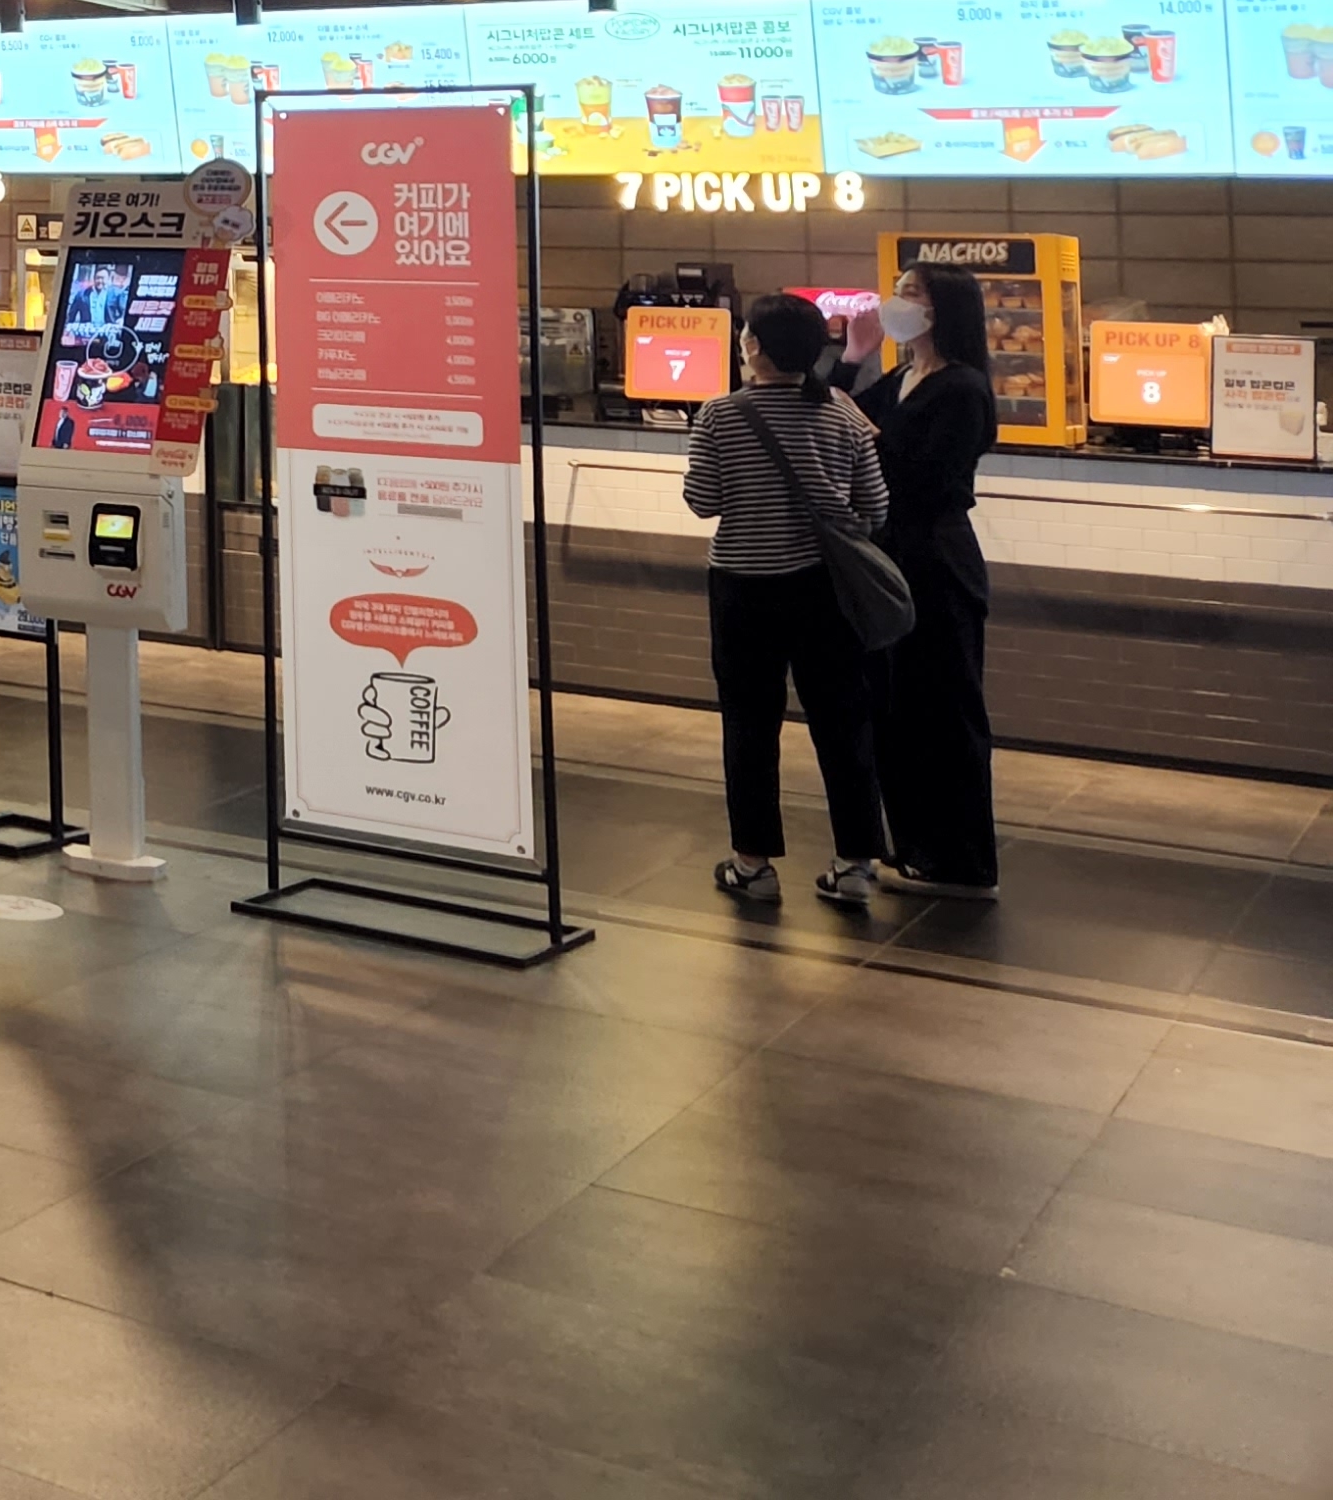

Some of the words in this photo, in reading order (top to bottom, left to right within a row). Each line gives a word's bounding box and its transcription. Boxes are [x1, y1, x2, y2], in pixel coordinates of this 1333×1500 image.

[361, 142, 415, 165] CGV
[76, 192, 120, 207] 주문은
[125, 192, 160, 207] 여기!
[393, 183, 471, 211] 커피가
[615, 173, 643, 210] 7
[654, 172, 755, 212] PICK
[761, 174, 822, 212] UP
[833, 171, 865, 212] 8
[72, 211, 185, 239] 키오스크
[394, 211, 471, 239] 여기에
[395, 240, 472, 267] 있어요
[918, 241, 1009, 264] NACHOS
[192, 273, 219, 286] TIP!
[638, 313, 678, 330] PICK
[680, 315, 702, 330] UP
[708, 317, 719, 331] 7
[1104, 330, 1151, 347] PICK
[1155, 333, 1181, 348] UP
[1188, 334, 1201, 348] 8
[668, 360, 687, 381] 7
[1142, 381, 1162, 404] 8
[107, 584, 137, 599] CGV
[410, 686, 432, 751] COFFEE
[365, 784, 447, 806] www.cgv.co.kr
